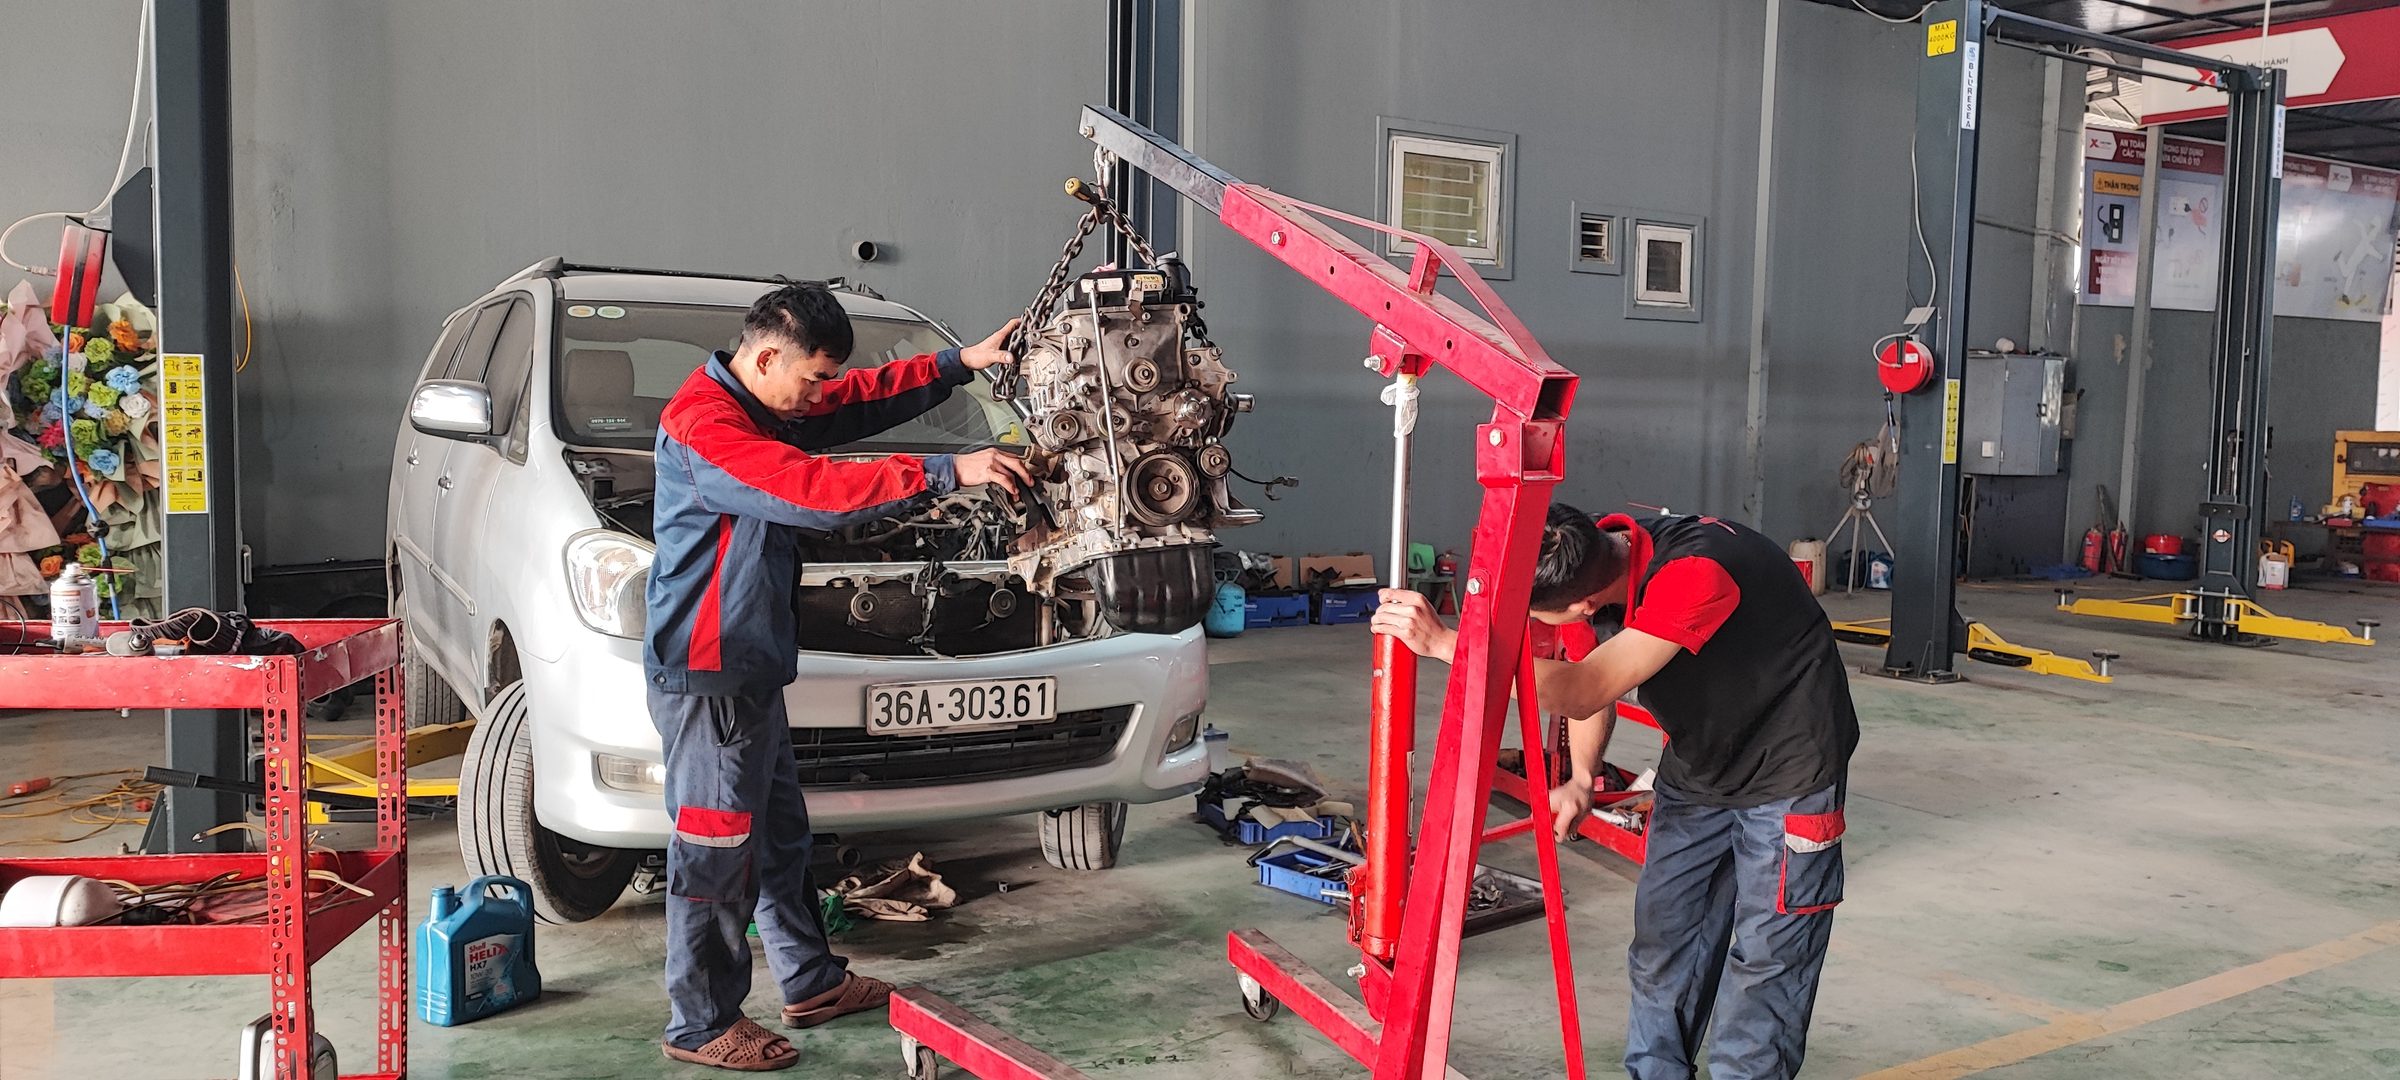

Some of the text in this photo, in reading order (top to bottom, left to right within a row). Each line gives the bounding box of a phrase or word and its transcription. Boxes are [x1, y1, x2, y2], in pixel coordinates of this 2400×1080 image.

[1935, 23, 1950, 31] MAX
[1929, 32, 1955, 42] 4000KG
[875, 683, 1047, 727] 36A-303.61
[470, 960, 488, 971] HX7
